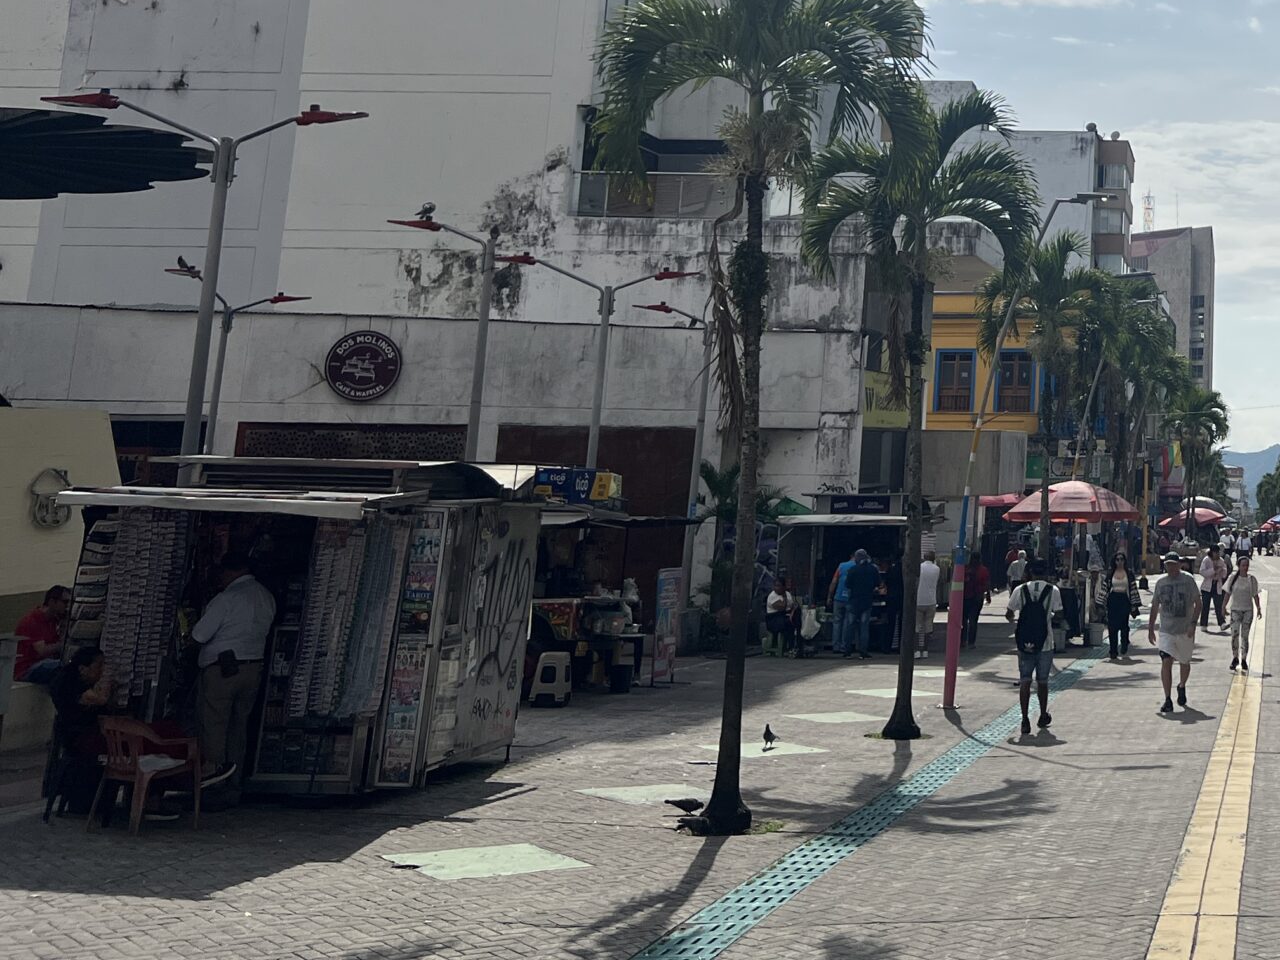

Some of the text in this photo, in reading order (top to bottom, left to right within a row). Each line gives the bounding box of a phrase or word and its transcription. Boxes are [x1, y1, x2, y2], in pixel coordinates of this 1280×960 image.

[336, 335, 396, 359] DOS MOLINOS
[356, 384, 385, 397] WAFFLES
[405, 590, 432, 599] TAROT
